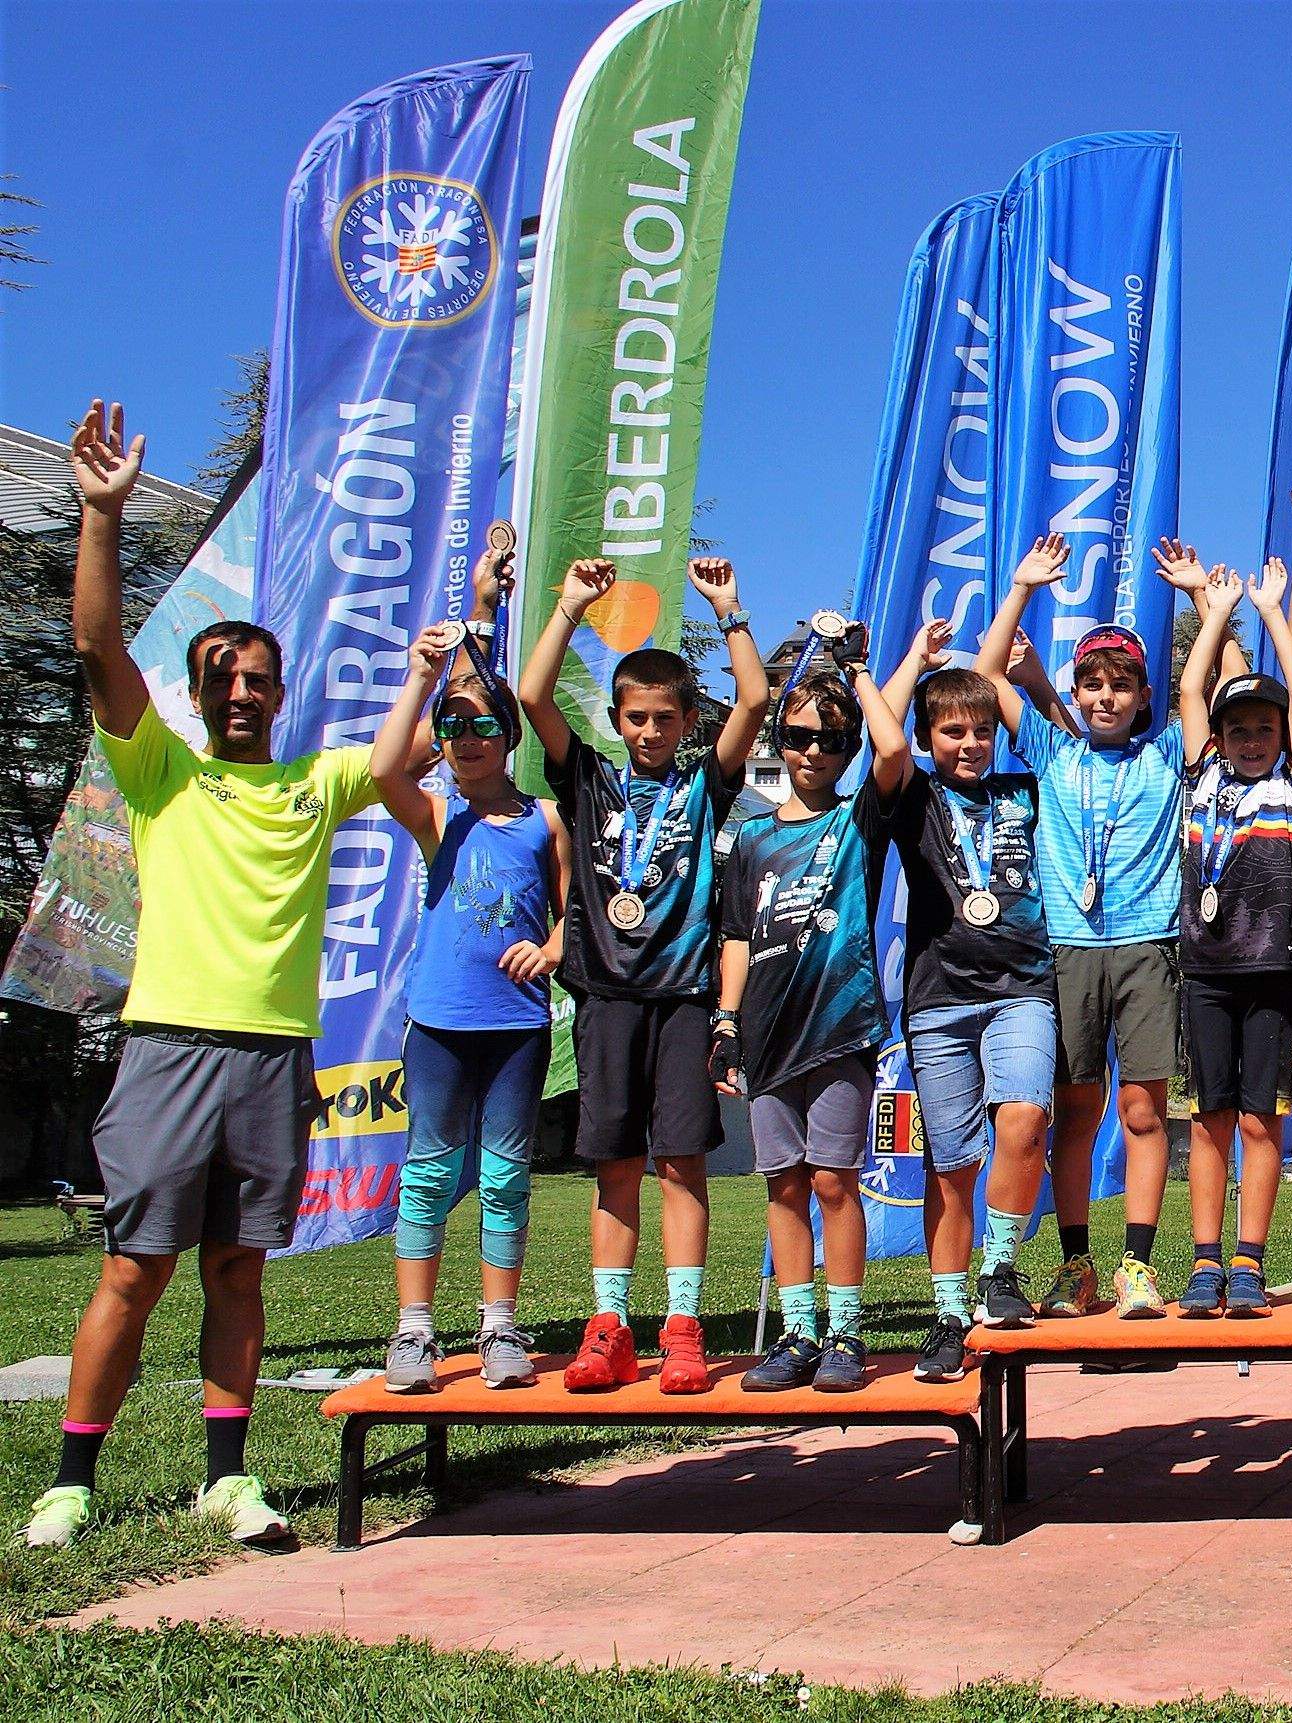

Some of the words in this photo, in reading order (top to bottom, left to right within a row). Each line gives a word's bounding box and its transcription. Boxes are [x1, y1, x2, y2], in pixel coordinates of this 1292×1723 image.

[343, 181, 419, 236] FEDERACIÓN
[425, 182, 488, 244] ARAGONESA
[402, 230, 435, 244] FADI
[343, 261, 397, 320] INVIERNO
[401, 306, 420, 319] DE
[428, 269, 485, 319] DEPORTES
[602, 117, 696, 557] IBERDROLA
[453, 413, 474, 511] Invierno
[446, 518, 471, 549] de
[315, 398, 417, 750] ARAGÓN
[444, 554, 470, 622] ortes
[1117, 578, 1137, 631] OLA
[495, 623, 507, 673] SPAINSNOW
[791, 635, 819, 683] SPAINSNOW
[623, 829, 634, 879] SPAINSNOW
[636, 818, 660, 864] SPAINSNOW
[50, 912, 82, 934] TURISMO
[312, 1067, 408, 1132] TOK
[876, 1092, 895, 1152] RFEDI
[298, 1163, 400, 1216] SW
